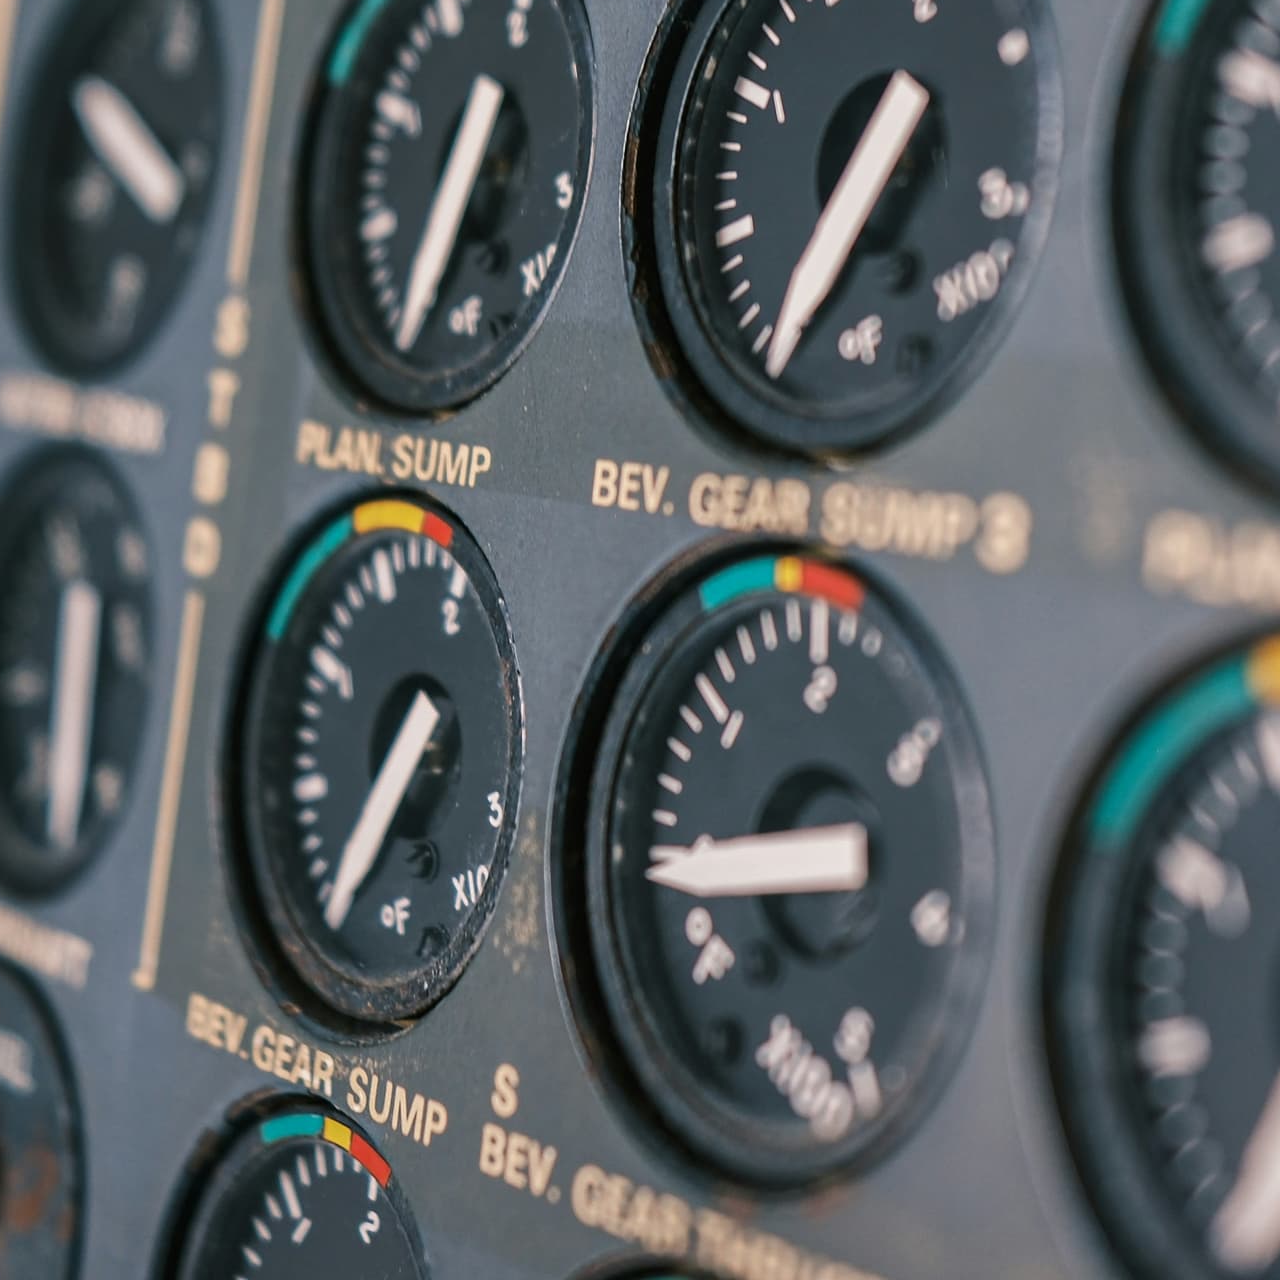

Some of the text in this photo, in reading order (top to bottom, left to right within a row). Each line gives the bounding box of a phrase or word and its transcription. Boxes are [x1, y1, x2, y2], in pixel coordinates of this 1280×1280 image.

[772, 89, 785, 124] 1
[555, 170, 574, 210] 3
[392, 434, 492, 488] SUMP
[591, 458, 675, 517] BEV.
[687, 472, 812, 538] GEAR
[820, 482, 979, 561] SUMP
[442, 598, 461, 636] 2
[487, 791, 503, 828] 3
[186, 992, 449, 1147] BEV. GEAR SUMP
[490, 1062, 520, 1119] S
[480, 1122, 561, 1204] BEV.
[570, 1163, 692, 1257] GEAR
[359, 1211, 380, 1245] 2
